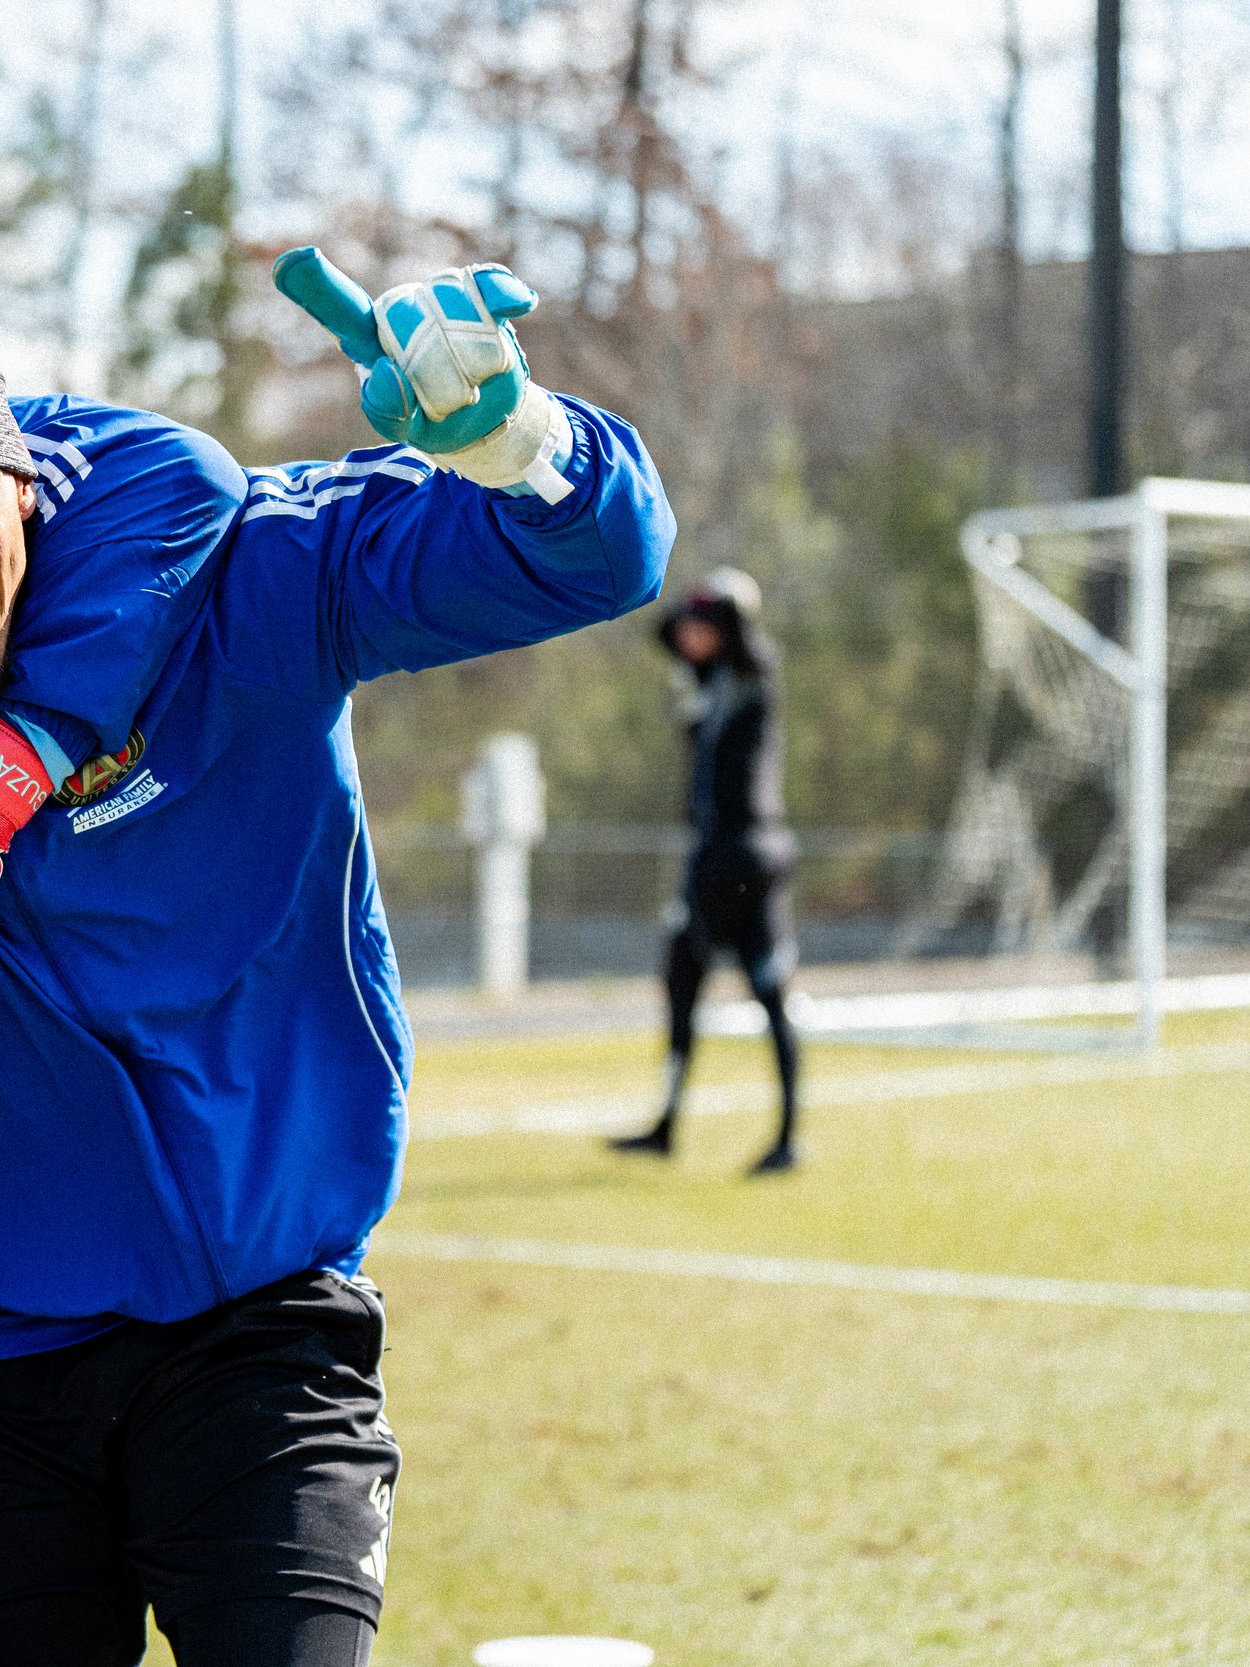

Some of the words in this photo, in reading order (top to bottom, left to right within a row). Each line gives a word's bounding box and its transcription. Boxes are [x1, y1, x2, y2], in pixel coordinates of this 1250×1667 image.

[73, 795, 124, 826] AMERICAN
[123, 775, 156, 802] FAMILY
[82, 789, 157, 829] INSURANCE
